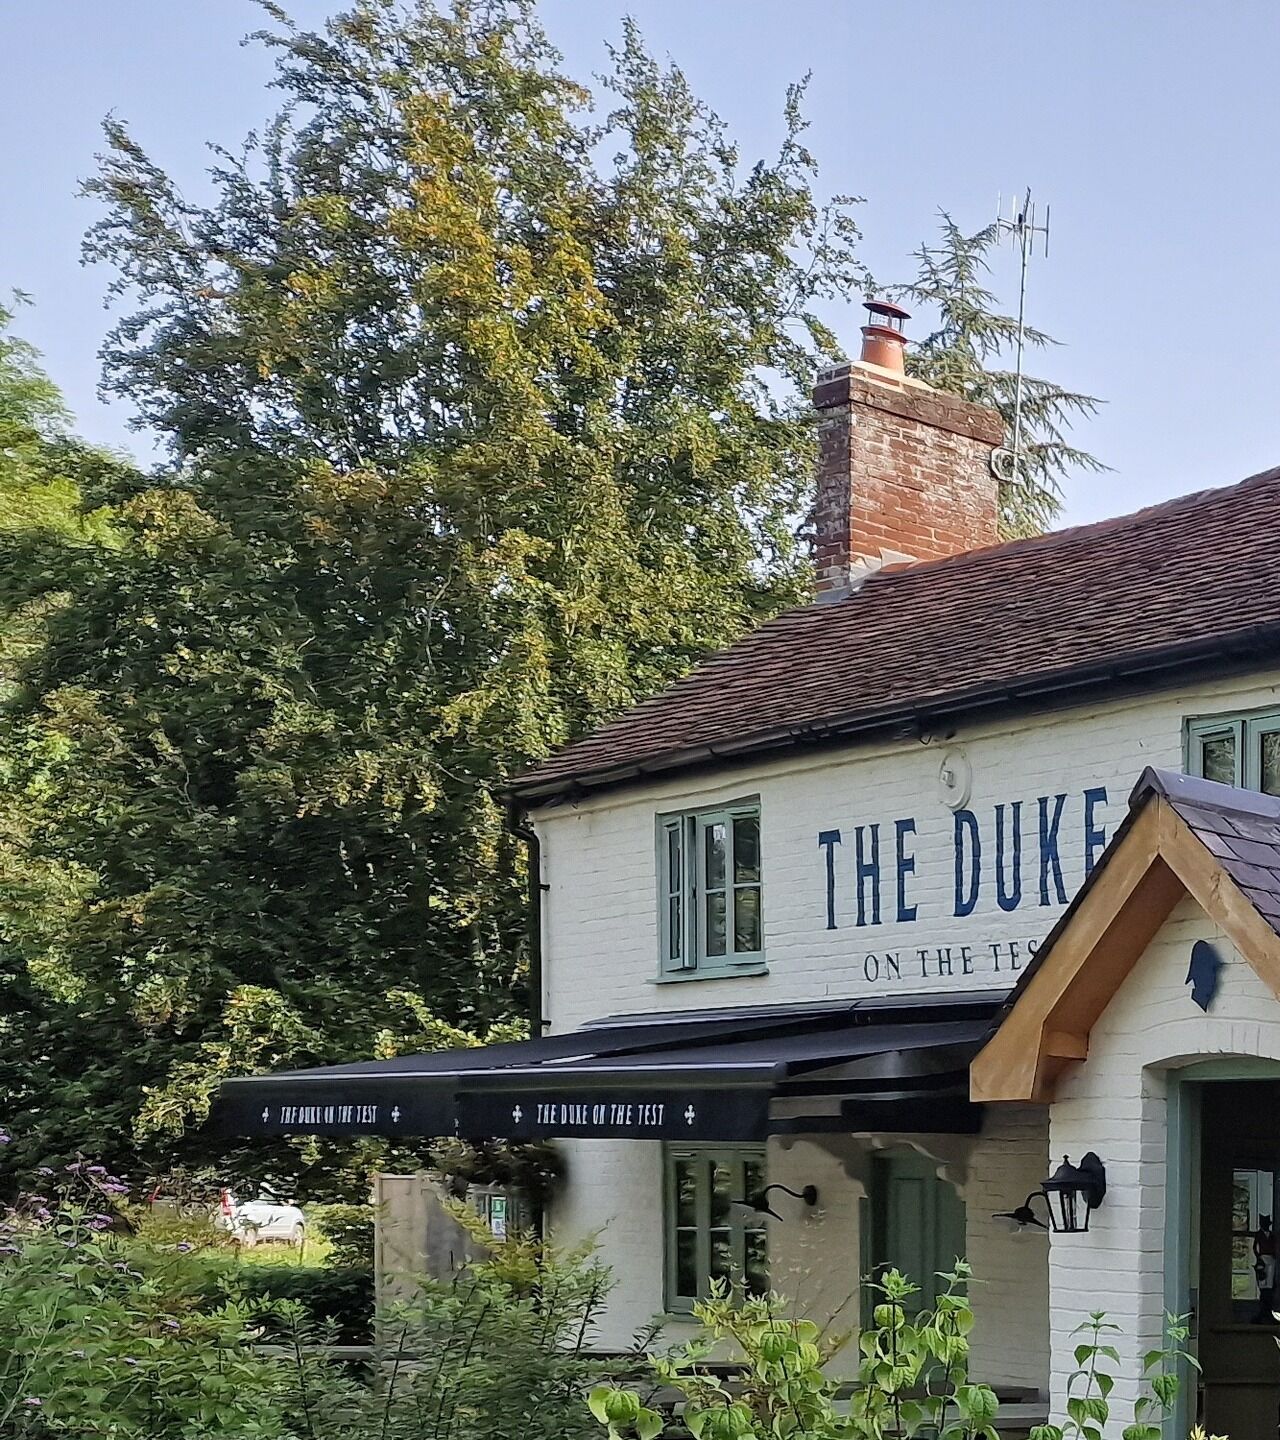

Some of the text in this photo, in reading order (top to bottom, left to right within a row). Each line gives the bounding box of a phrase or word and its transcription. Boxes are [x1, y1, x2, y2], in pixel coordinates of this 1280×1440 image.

[818, 786, 1108, 930] THE DUKE
[864, 939, 1038, 983] ON THE TES
[356, 1104, 378, 1123] TEST
[537, 1104, 664, 1126] THE DUKE ON THE TEST
